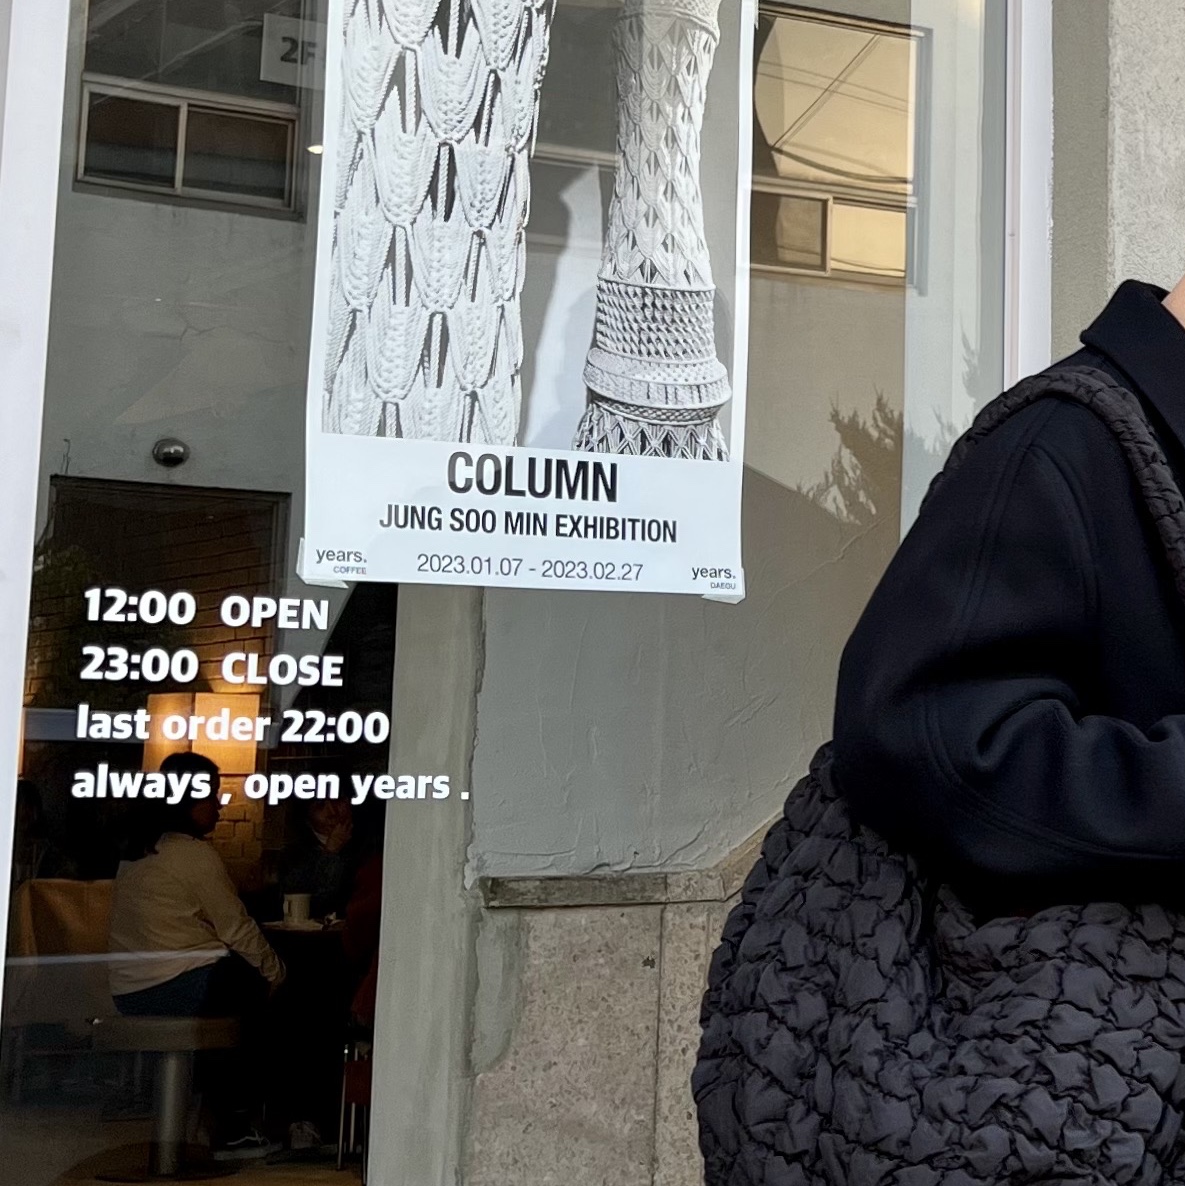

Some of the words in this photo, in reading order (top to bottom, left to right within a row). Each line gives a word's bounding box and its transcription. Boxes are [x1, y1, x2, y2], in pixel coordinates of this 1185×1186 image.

[280, 36, 317, 65] 2F
[447, 451, 618, 503] COLUMN
[379, 503, 443, 531] JUNG
[449, 507, 497, 533] SOO
[504, 510, 548, 537] MIN
[555, 513, 677, 543] EXHIBITION
[316, 548, 368, 564] years.
[333, 565, 367, 575] COFFEE
[417, 553, 523, 577] 2023.01.07
[541, 559, 644, 582] 2023.02.27
[691, 566, 737, 581] years.
[84, 587, 196, 625] 12:00
[220, 595, 329, 630] OPEN
[80, 645, 199, 683] 23:00
[221, 652, 344, 687] CLOSE
[76, 704, 150, 740] last
[162, 707, 271, 741] order
[281, 710, 390, 744] 22:00
[244, 773, 340, 805] open
